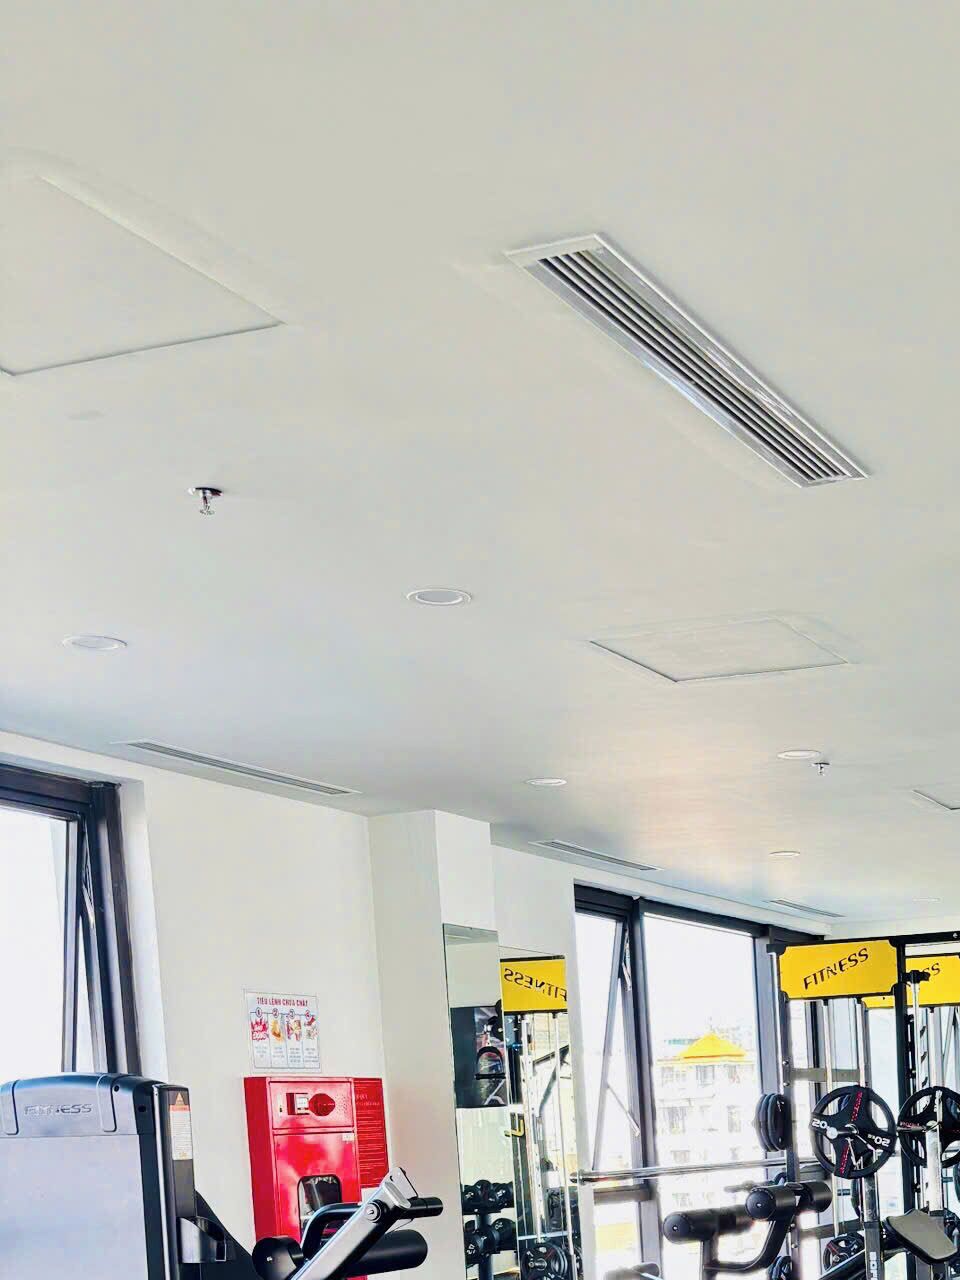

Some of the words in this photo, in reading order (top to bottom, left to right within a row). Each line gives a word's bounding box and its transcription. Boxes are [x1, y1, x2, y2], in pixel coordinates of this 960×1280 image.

[802, 947, 870, 991] FITNESS
[811, 1118, 828, 1129] 20
[873, 1136, 891, 1148] 20
